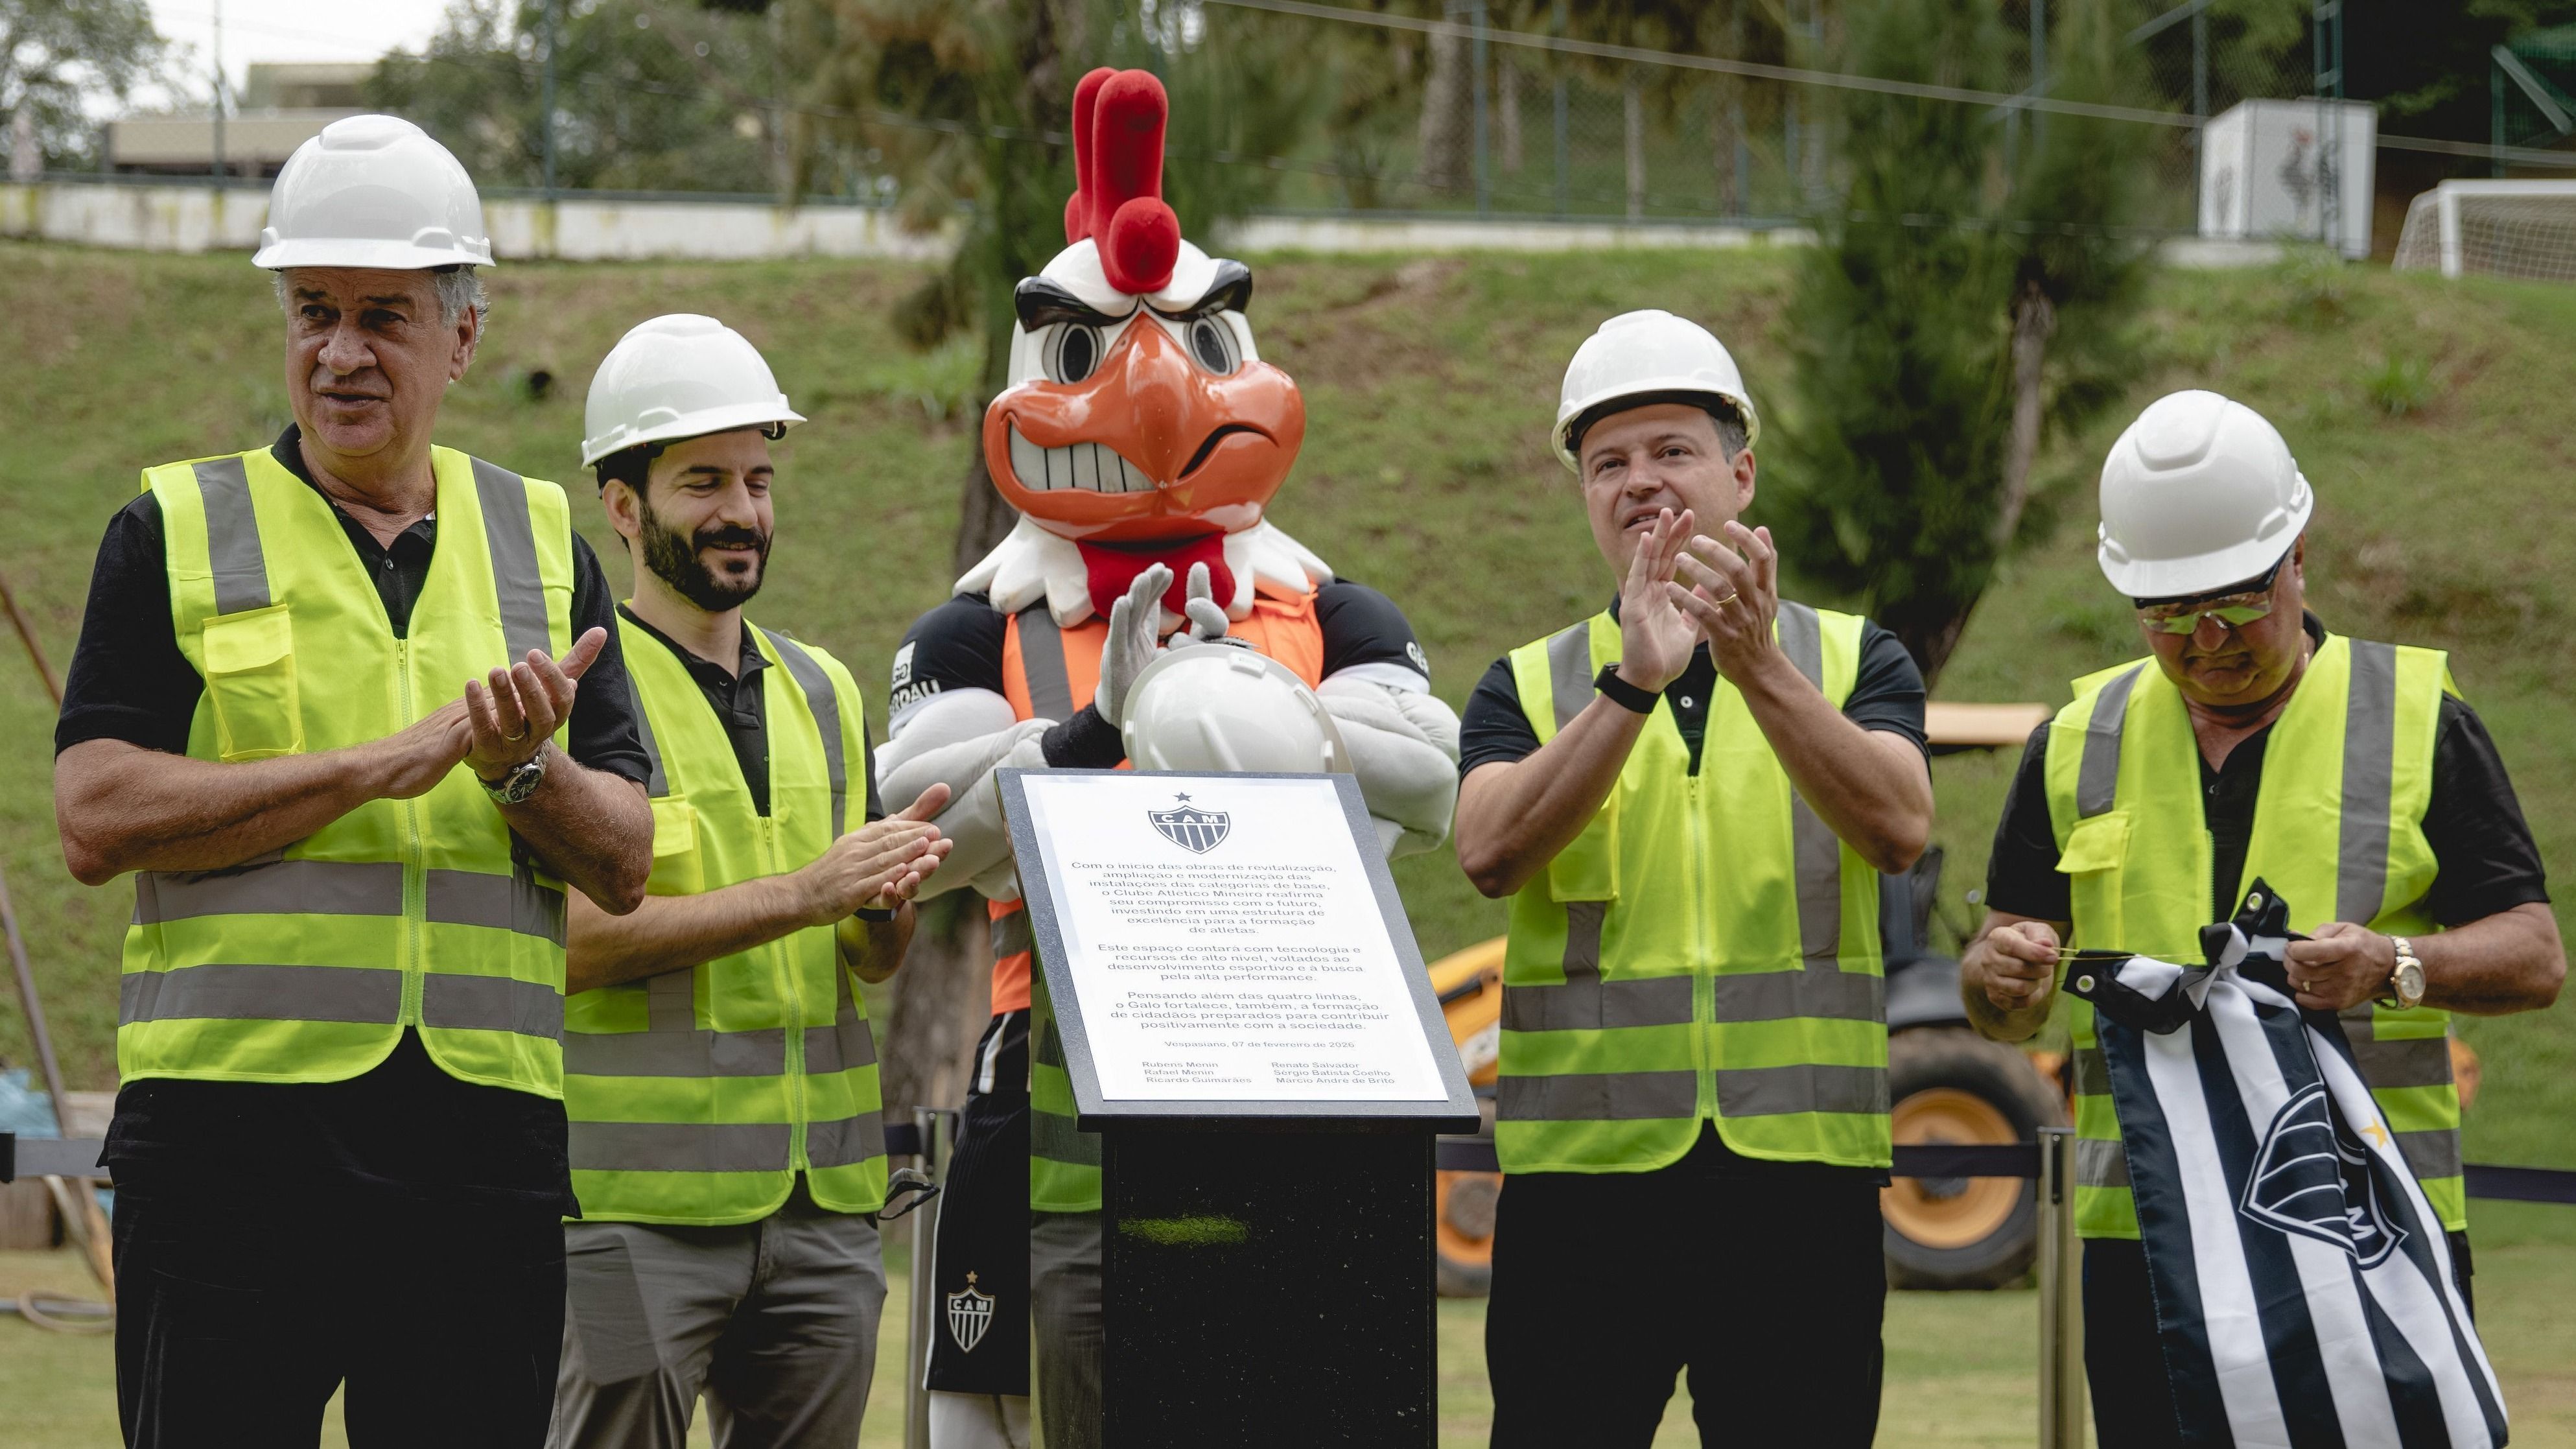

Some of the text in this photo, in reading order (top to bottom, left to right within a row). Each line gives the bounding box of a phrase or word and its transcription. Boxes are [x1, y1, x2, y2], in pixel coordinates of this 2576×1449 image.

[1161, 814, 1219, 823] CAM
[1199, 880, 1270, 890] categorias
[1293, 882, 1330, 891] base,
[1138, 898, 1229, 908] compromisso
[1276, 899, 1322, 908] futuro,
[1276, 945, 1350, 954] tecnologia
[1229, 963, 1294, 972] esportivo
[1160, 972, 1190, 982] pela
[1223, 973, 1317, 982] performance.
[1267, 993, 1312, 1002] quatro
[1315, 993, 1361, 1002] linhas,
[1164, 1001, 1232, 1011] fortalece,
[1200, 1011, 1282, 1020] preparados
[1140, 1020, 1240, 1030] positivamente
[952, 1299, 988, 1312] CAM
